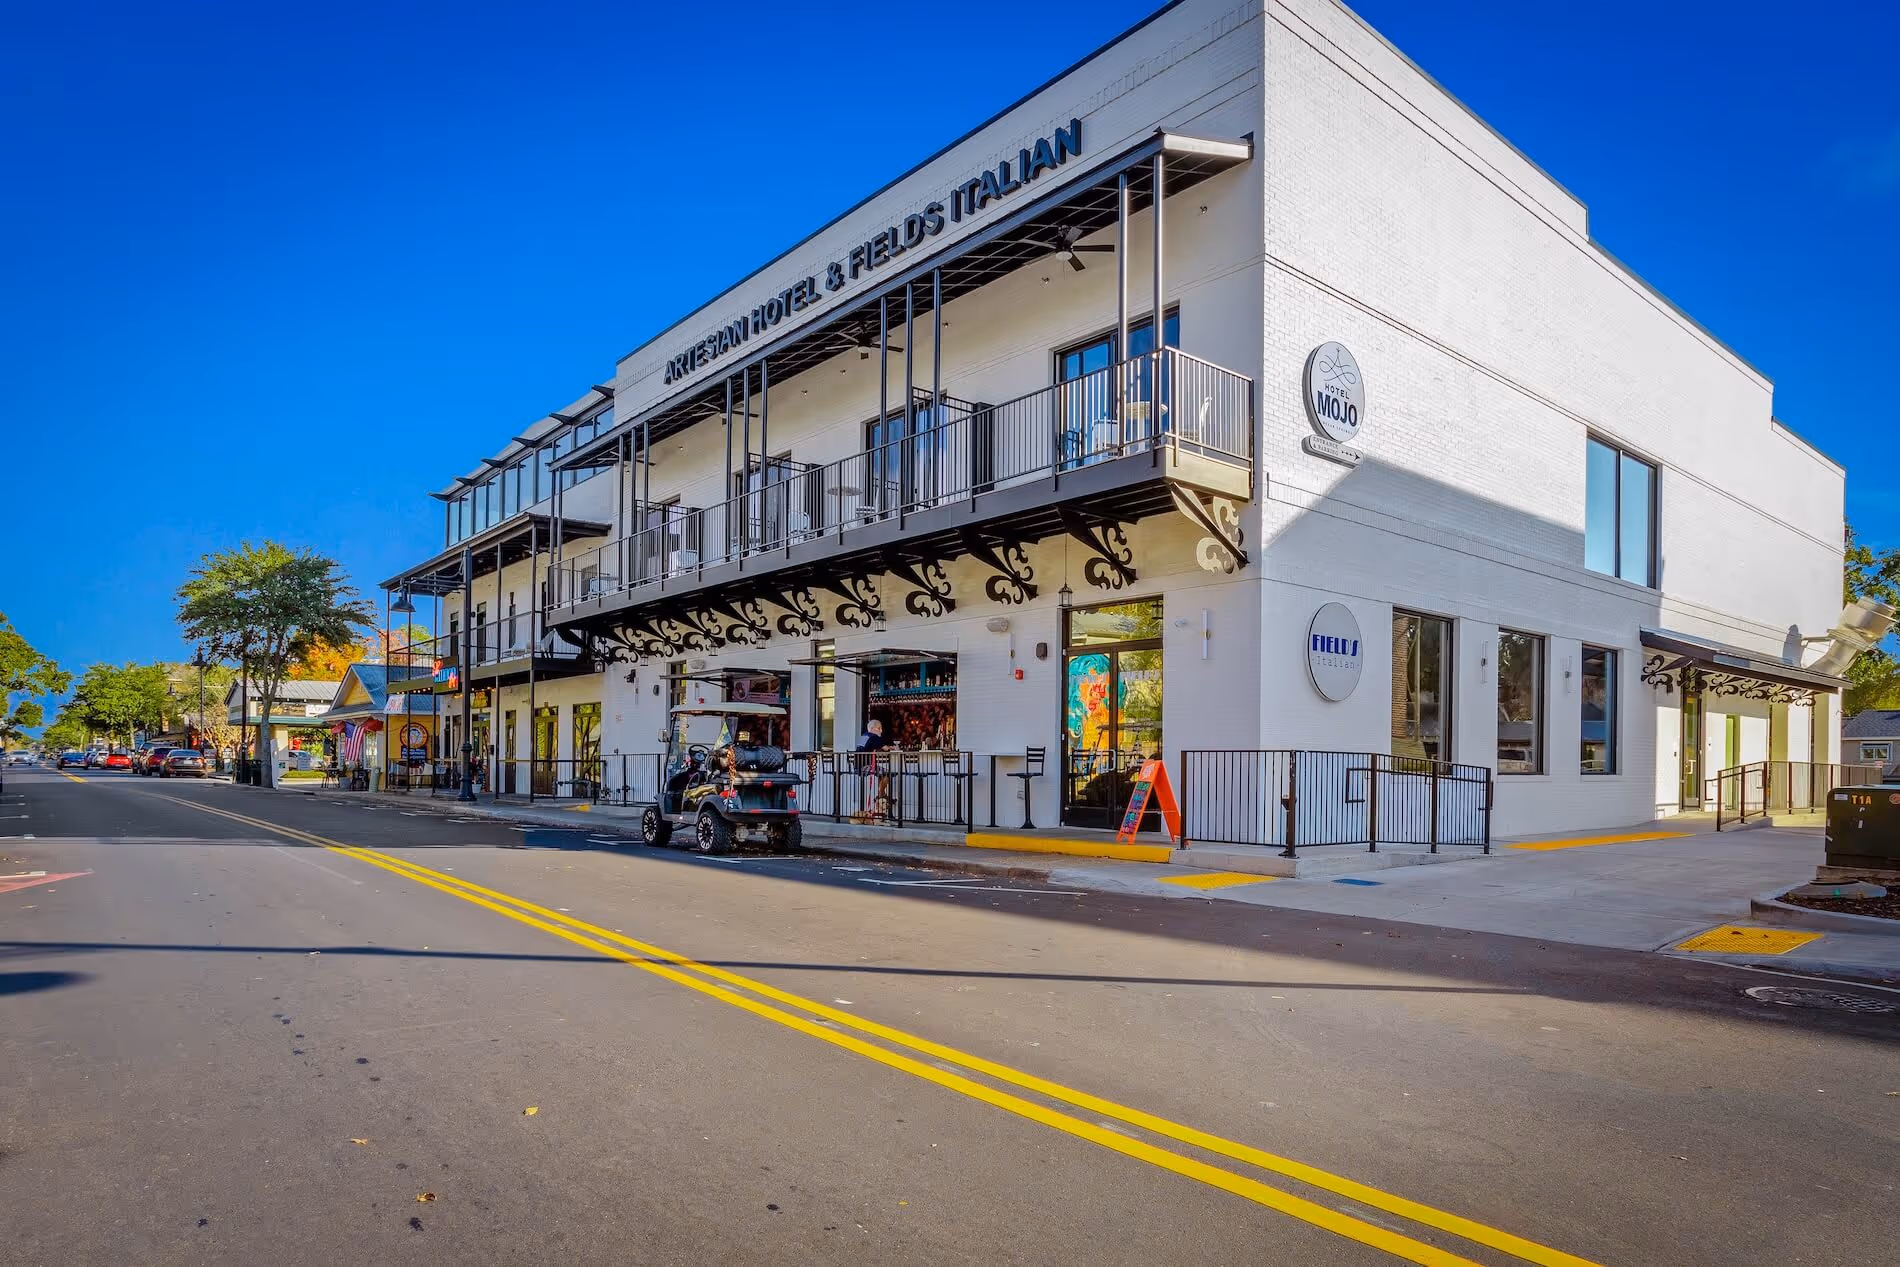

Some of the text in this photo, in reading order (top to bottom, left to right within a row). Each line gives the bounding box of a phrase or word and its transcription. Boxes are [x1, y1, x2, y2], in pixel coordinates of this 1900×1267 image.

[663, 117, 1083, 384] ARTESIAN HOTEL & FIELDS ITALIAN
[1324, 383, 1350, 400] HOTEL
[1317, 390, 1358, 427] MOJO
[1852, 795, 1871, 804] T1A
